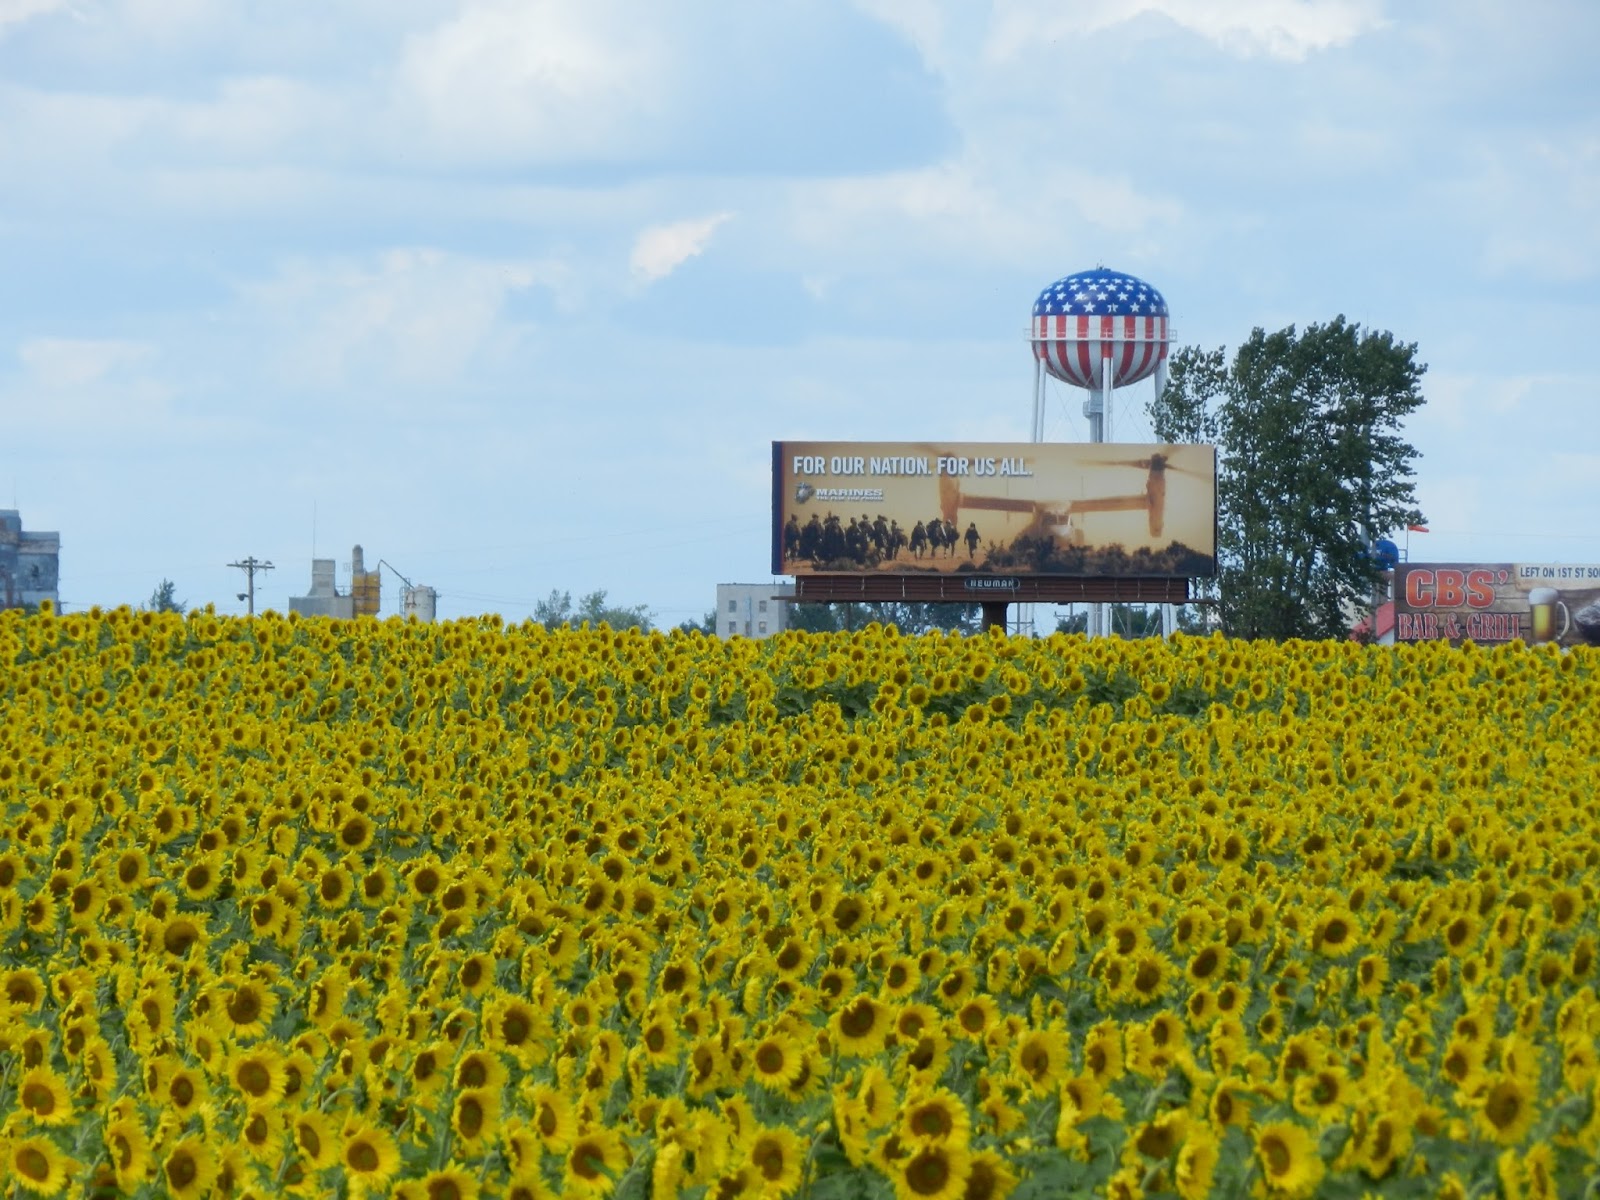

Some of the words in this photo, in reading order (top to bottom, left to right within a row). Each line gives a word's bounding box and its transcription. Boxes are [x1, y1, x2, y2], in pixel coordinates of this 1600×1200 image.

[793, 456, 826, 475] FOR
[831, 456, 865, 475] OUR
[870, 456, 932, 476] NATION.
[937, 457, 970, 476] FOR
[974, 457, 996, 476] US
[1000, 457, 1033, 476] ALL.
[815, 488, 883, 497] MARINES
[1520, 567, 1540, 577] LEFT
[1543, 567, 1555, 578] ON
[1557, 567, 1573, 578] 1ST
[1575, 567, 1586, 578] ST
[1587, 567, 1600, 578] SO
[970, 579, 1014, 588] NEWMAN
[1398, 613, 1439, 640] BAR
[1444, 612, 1461, 639] &
[1466, 613, 1523, 640] GRILL
